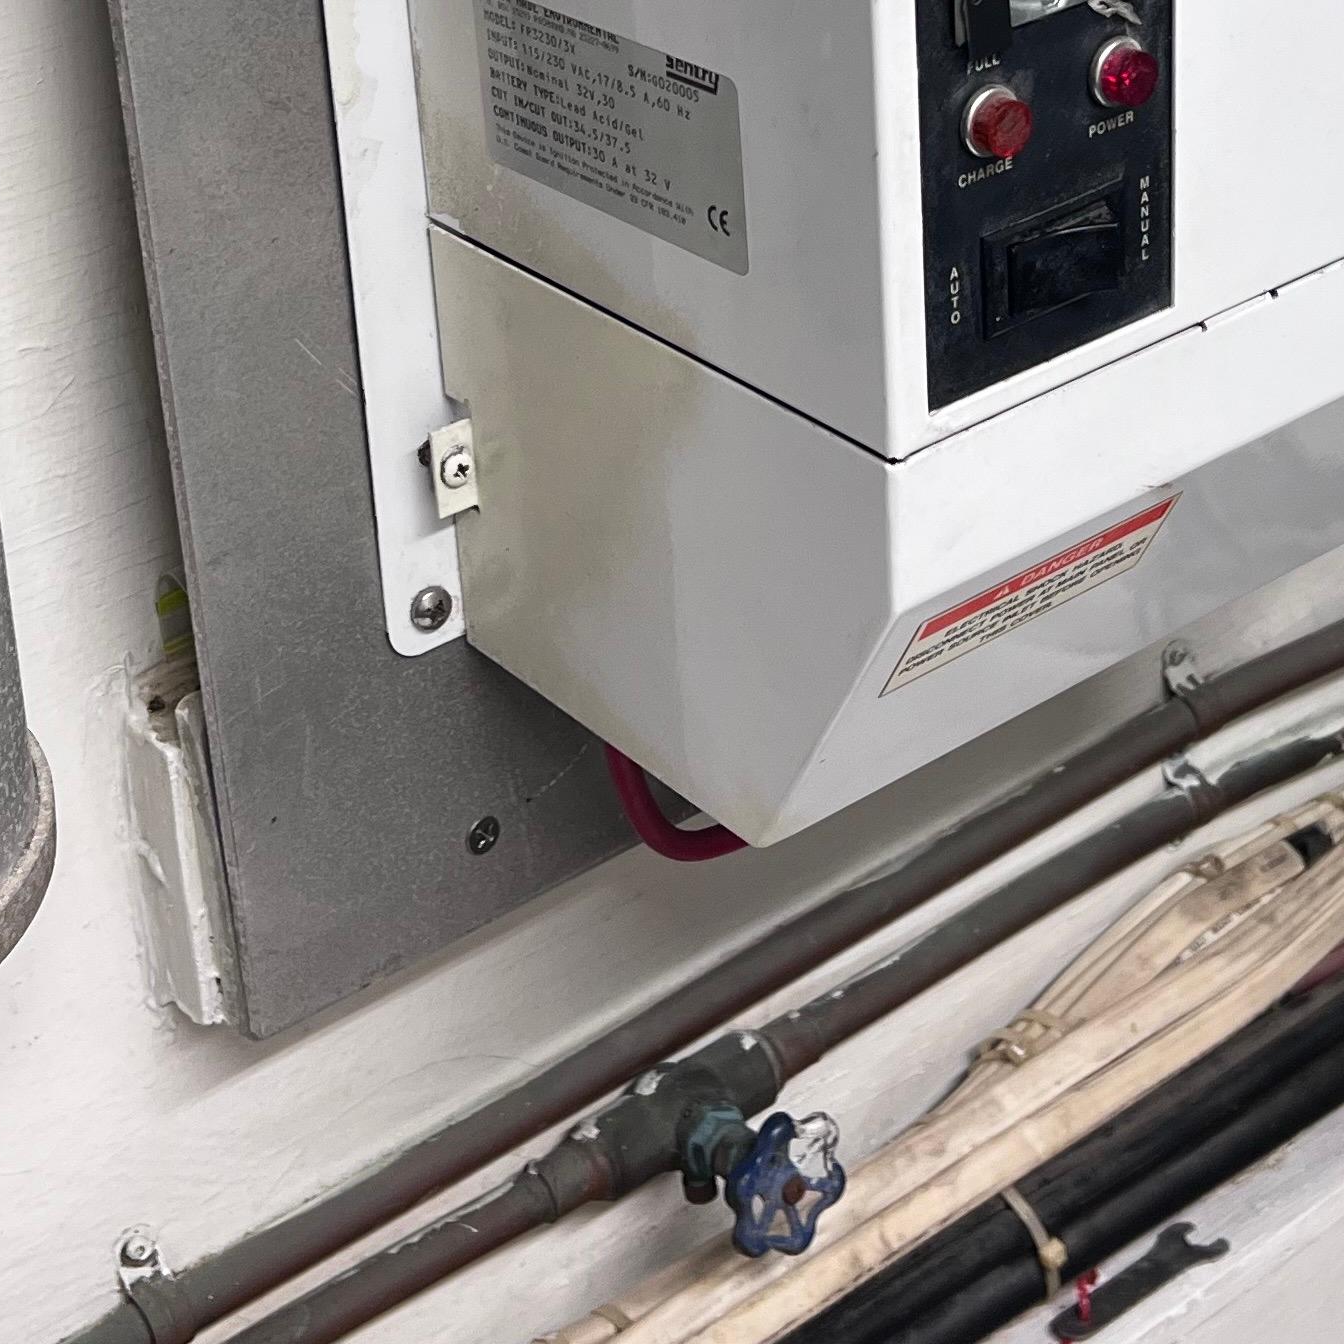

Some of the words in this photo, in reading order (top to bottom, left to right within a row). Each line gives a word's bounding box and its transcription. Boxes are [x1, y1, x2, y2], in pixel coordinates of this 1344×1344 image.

[489, 65, 528, 93] BATTERY
[522, 42, 566, 71] 115/230
[676, 103, 691, 121] Hz
[966, 54, 1002, 76] FULL
[1087, 110, 1135, 139] POWER
[492, 104, 549, 138] CONTINUOUS
[643, 168, 658, 186] 32
[957, 155, 1014, 189] CHARGE
[1139, 175, 1150, 261] MANUAL
[949, 266, 961, 326] AUTO
[1020, 536, 1105, 587] DANGER
[989, 594, 1037, 623] POWER
[897, 648, 945, 677] POWER
